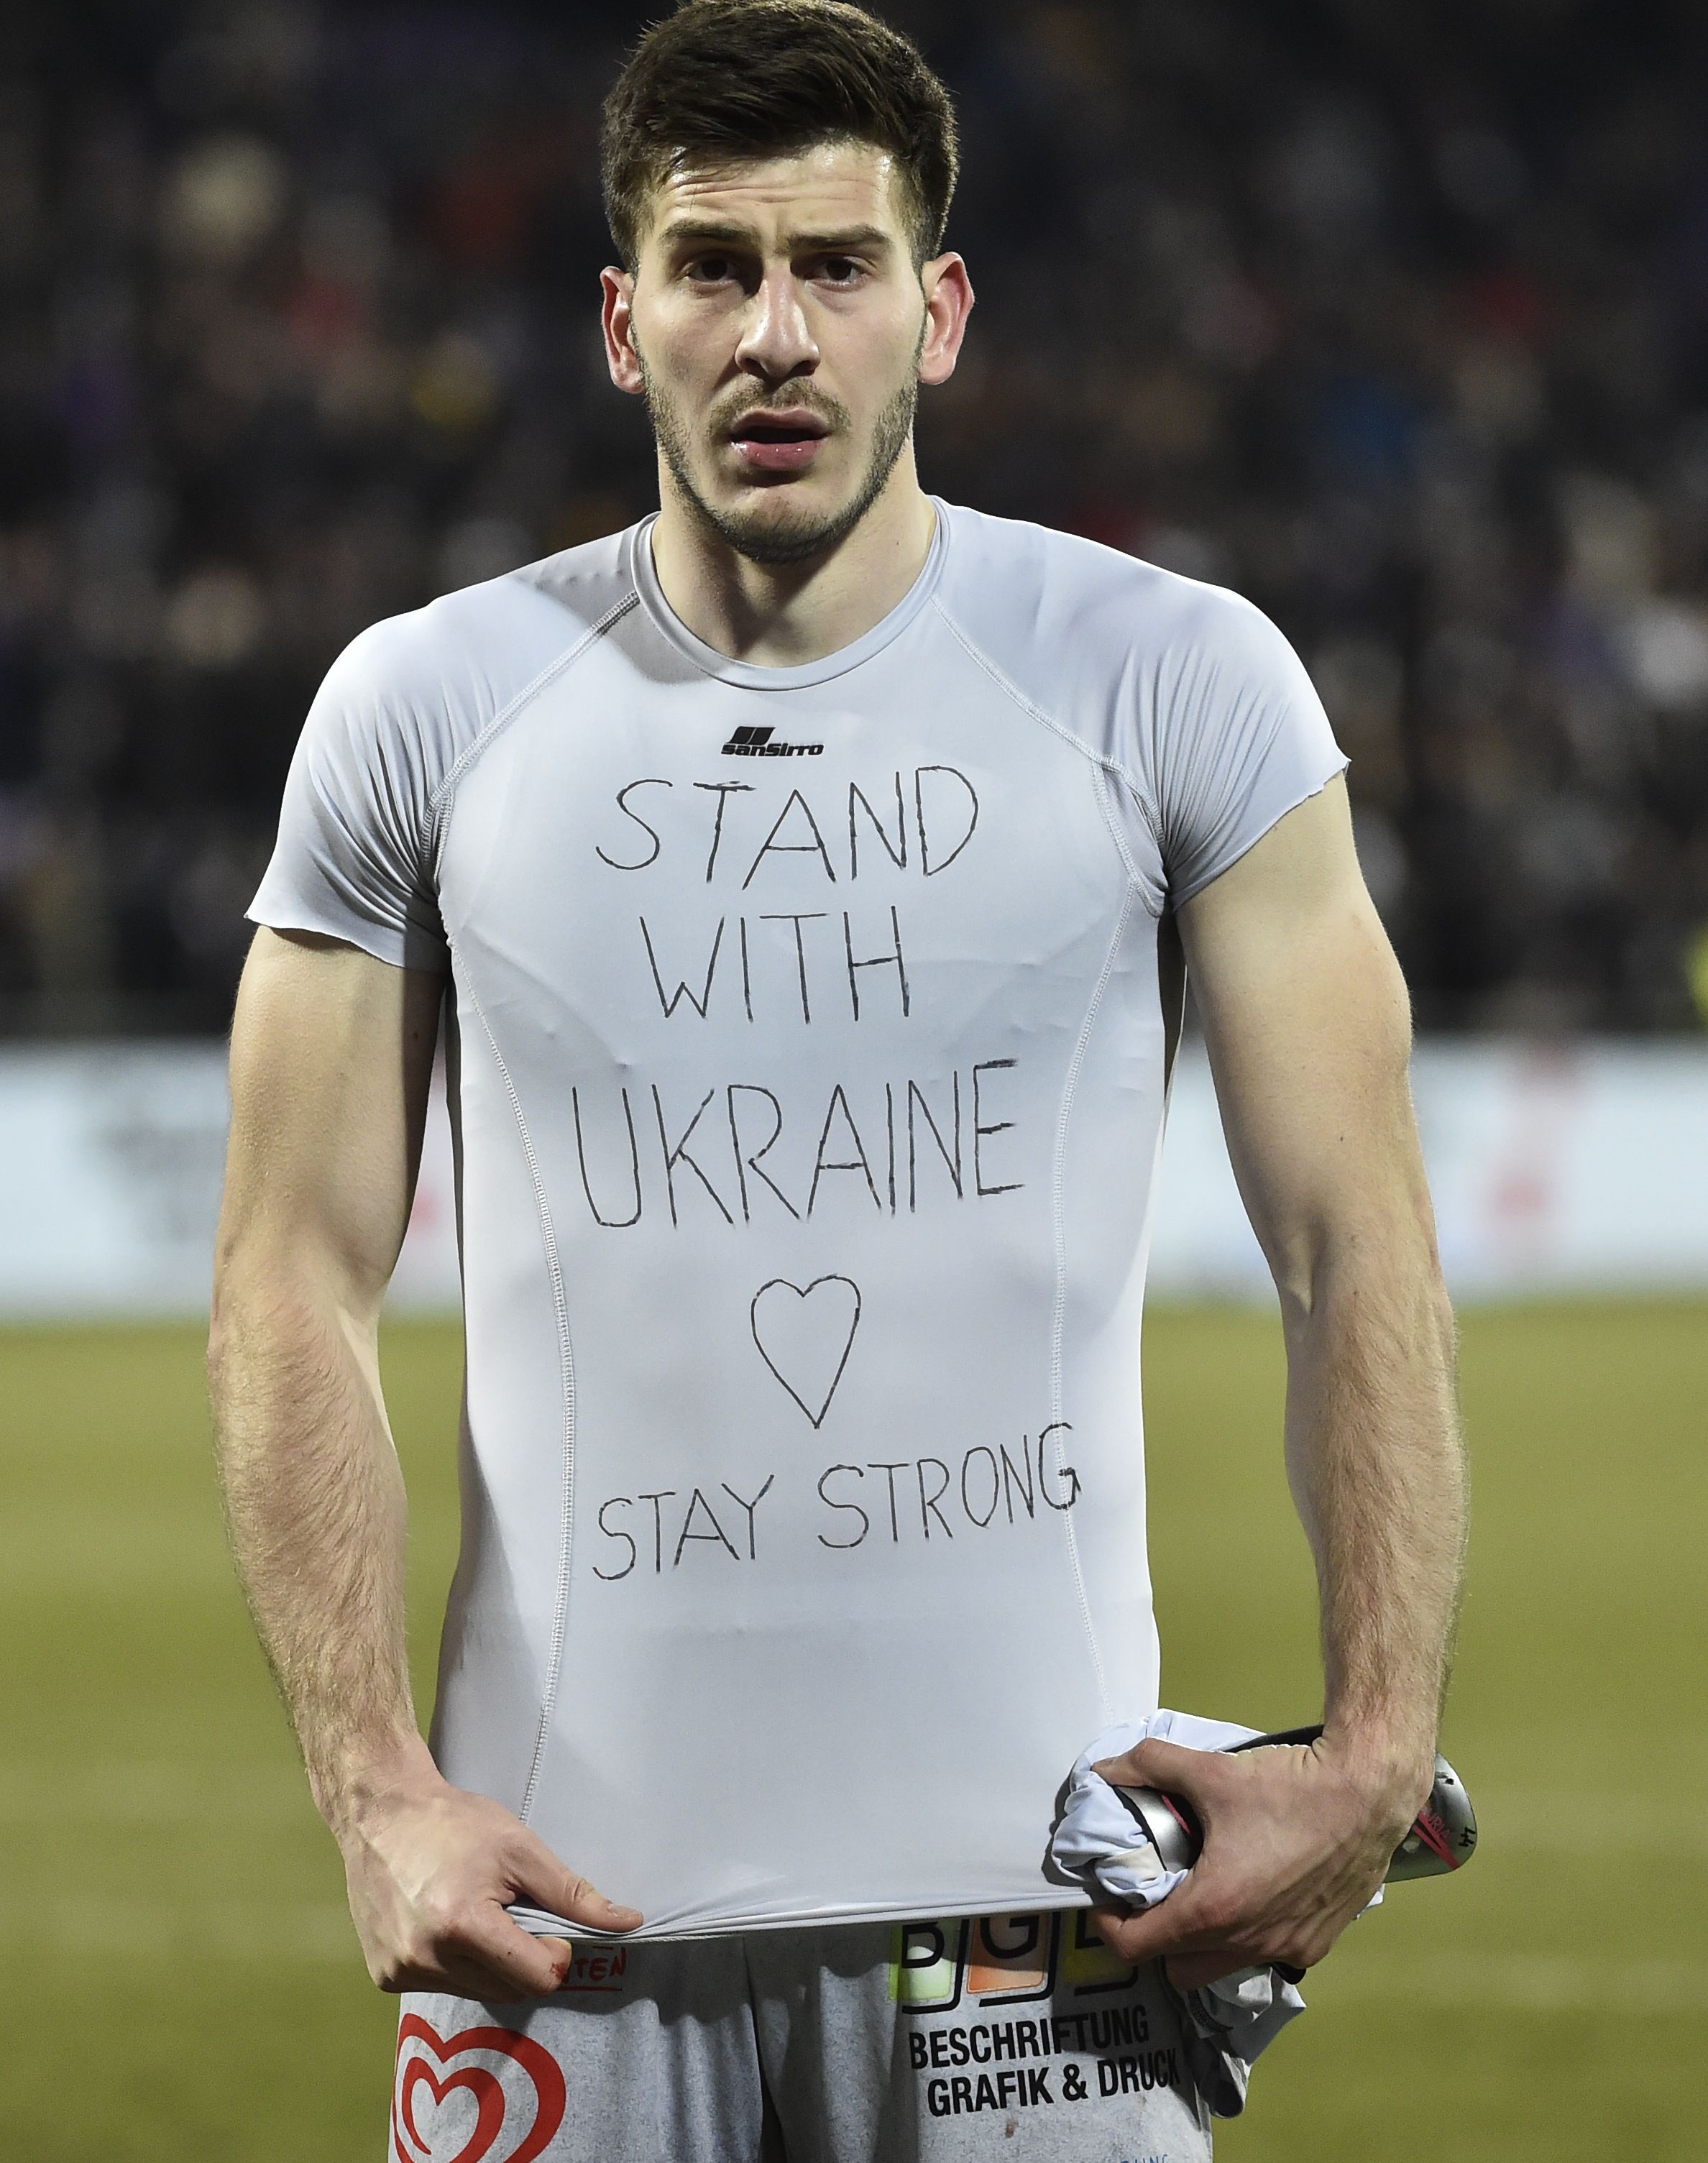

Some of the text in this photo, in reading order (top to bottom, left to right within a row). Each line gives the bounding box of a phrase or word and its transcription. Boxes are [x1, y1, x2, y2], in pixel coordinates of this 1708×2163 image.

[595, 765, 979, 890] STAND
[639, 904, 909, 1024] WITH
[572, 1058, 1025, 1230] UKRAINE
[592, 1421, 1082, 1581] STAY STRONG
[909, 2003, 1150, 2070] BESCHRIFTUNG
[927, 2047, 1181, 2118] GRAFIK & DRUCK
